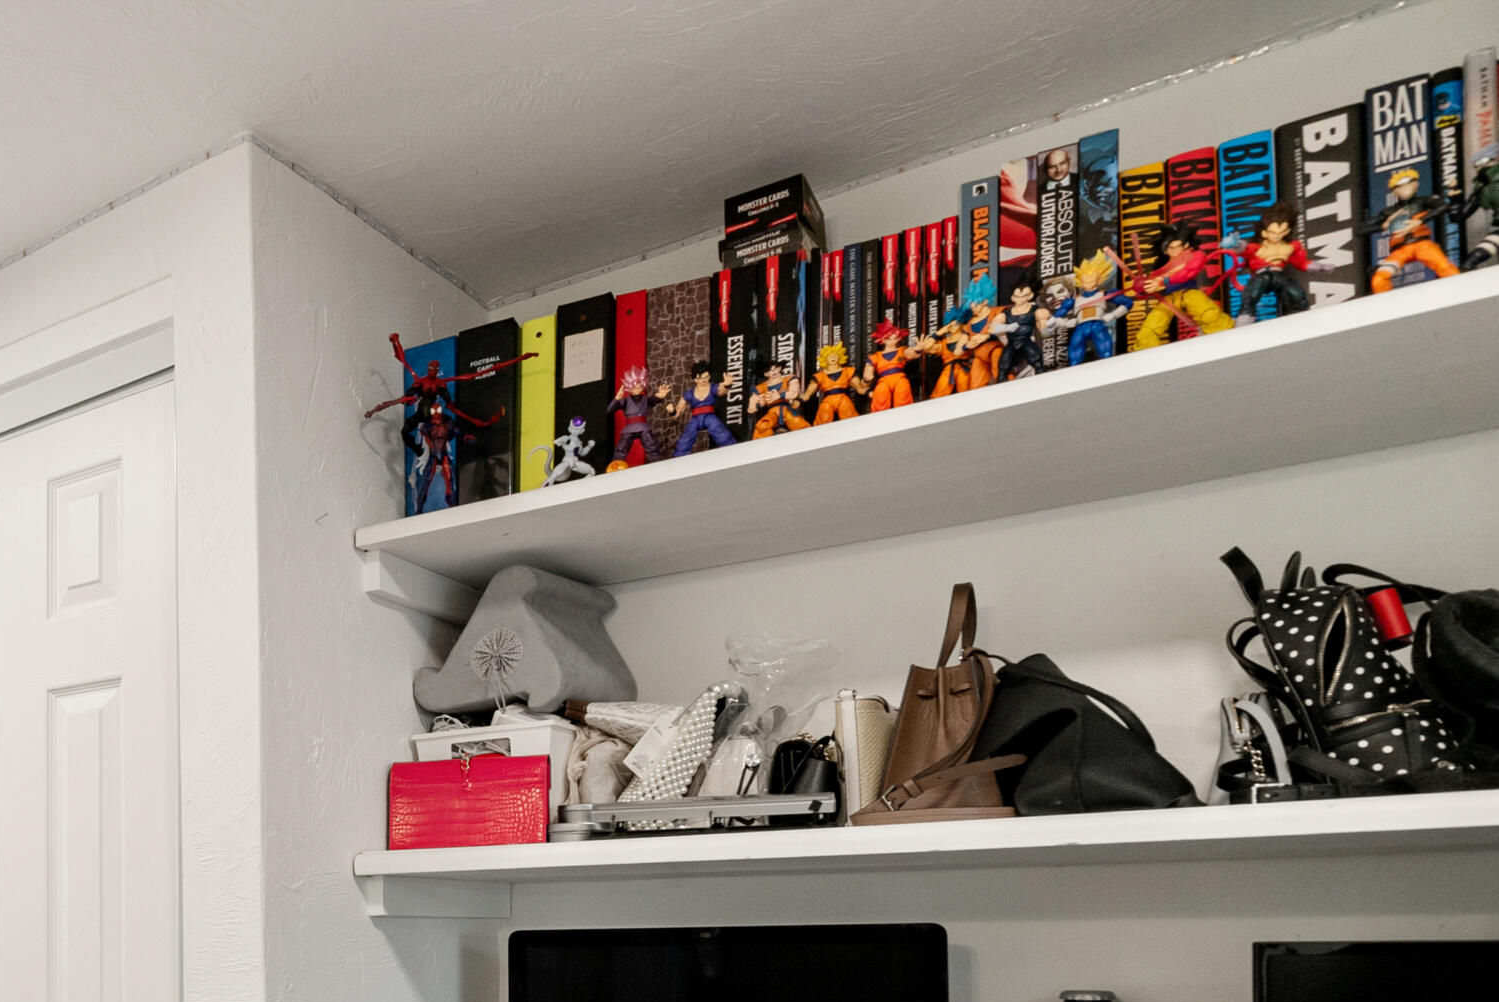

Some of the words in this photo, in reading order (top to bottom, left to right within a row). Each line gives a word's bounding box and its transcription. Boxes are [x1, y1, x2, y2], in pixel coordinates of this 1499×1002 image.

[1373, 78, 1428, 132] BAT
[1374, 121, 1428, 166] MAN
[737, 196, 768, 213] MONSTER
[768, 189, 790, 203] CARDS
[1222, 141, 1270, 248] BATMA
[736, 242, 768, 258] MONSTER
[768, 235, 790, 249] CARDS
[972, 205, 990, 266] BLACK
[1041, 191, 1056, 279] LUTHOR/JOKER
[1057, 189, 1074, 274] ABSOLUTE
[469, 355, 501, 368] FOOTBALL
[726, 404, 743, 425] KIT
